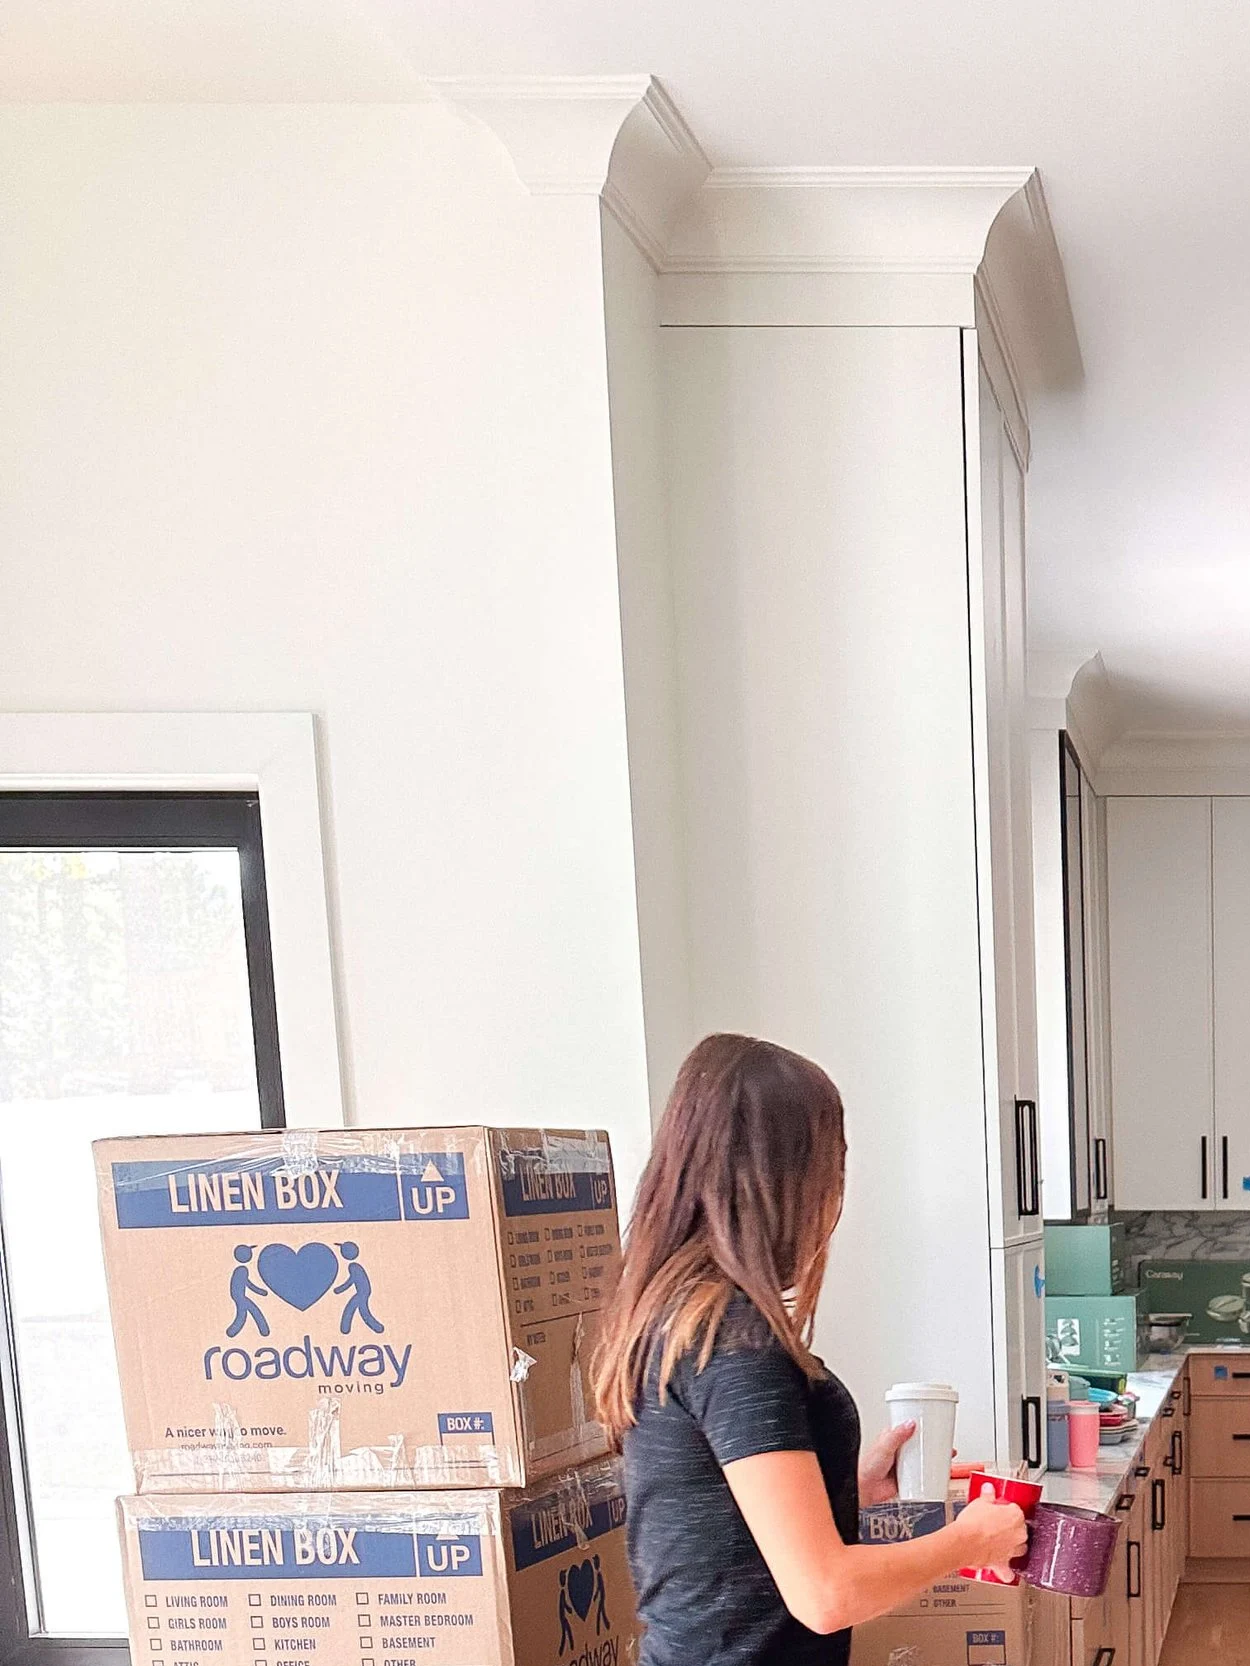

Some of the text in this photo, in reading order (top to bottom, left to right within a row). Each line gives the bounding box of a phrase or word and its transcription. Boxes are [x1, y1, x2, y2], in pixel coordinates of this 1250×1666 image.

[169, 1169, 343, 1214] LINEN BOX
[411, 1187, 456, 1215] UP
[204, 1335, 412, 1387] roadway
[318, 1382, 384, 1395] moving
[447, 1418, 472, 1431] BOX
[165, 1427, 174, 1438] A
[176, 1426, 206, 1438] nicer
[250, 1426, 287, 1437] move.
[191, 1527, 360, 1567] LINEN BOX
[427, 1544, 470, 1572] UP
[165, 1595, 229, 1608] LIVING ROOM
[270, 1594, 337, 1607] DINING ROOM
[378, 1592, 447, 1605] FAMILY ROOM
[168, 1617, 227, 1630] GIRLS ROOM
[272, 1615, 330, 1629] BOYS ROOM
[380, 1613, 473, 1627] MASTER BEDROOM
[274, 1638, 316, 1651] KITCHEN
[381, 1636, 436, 1649] BASEMENT
[973, 1633, 988, 1643] BOX
[170, 1639, 222, 1651] BATHROOM
